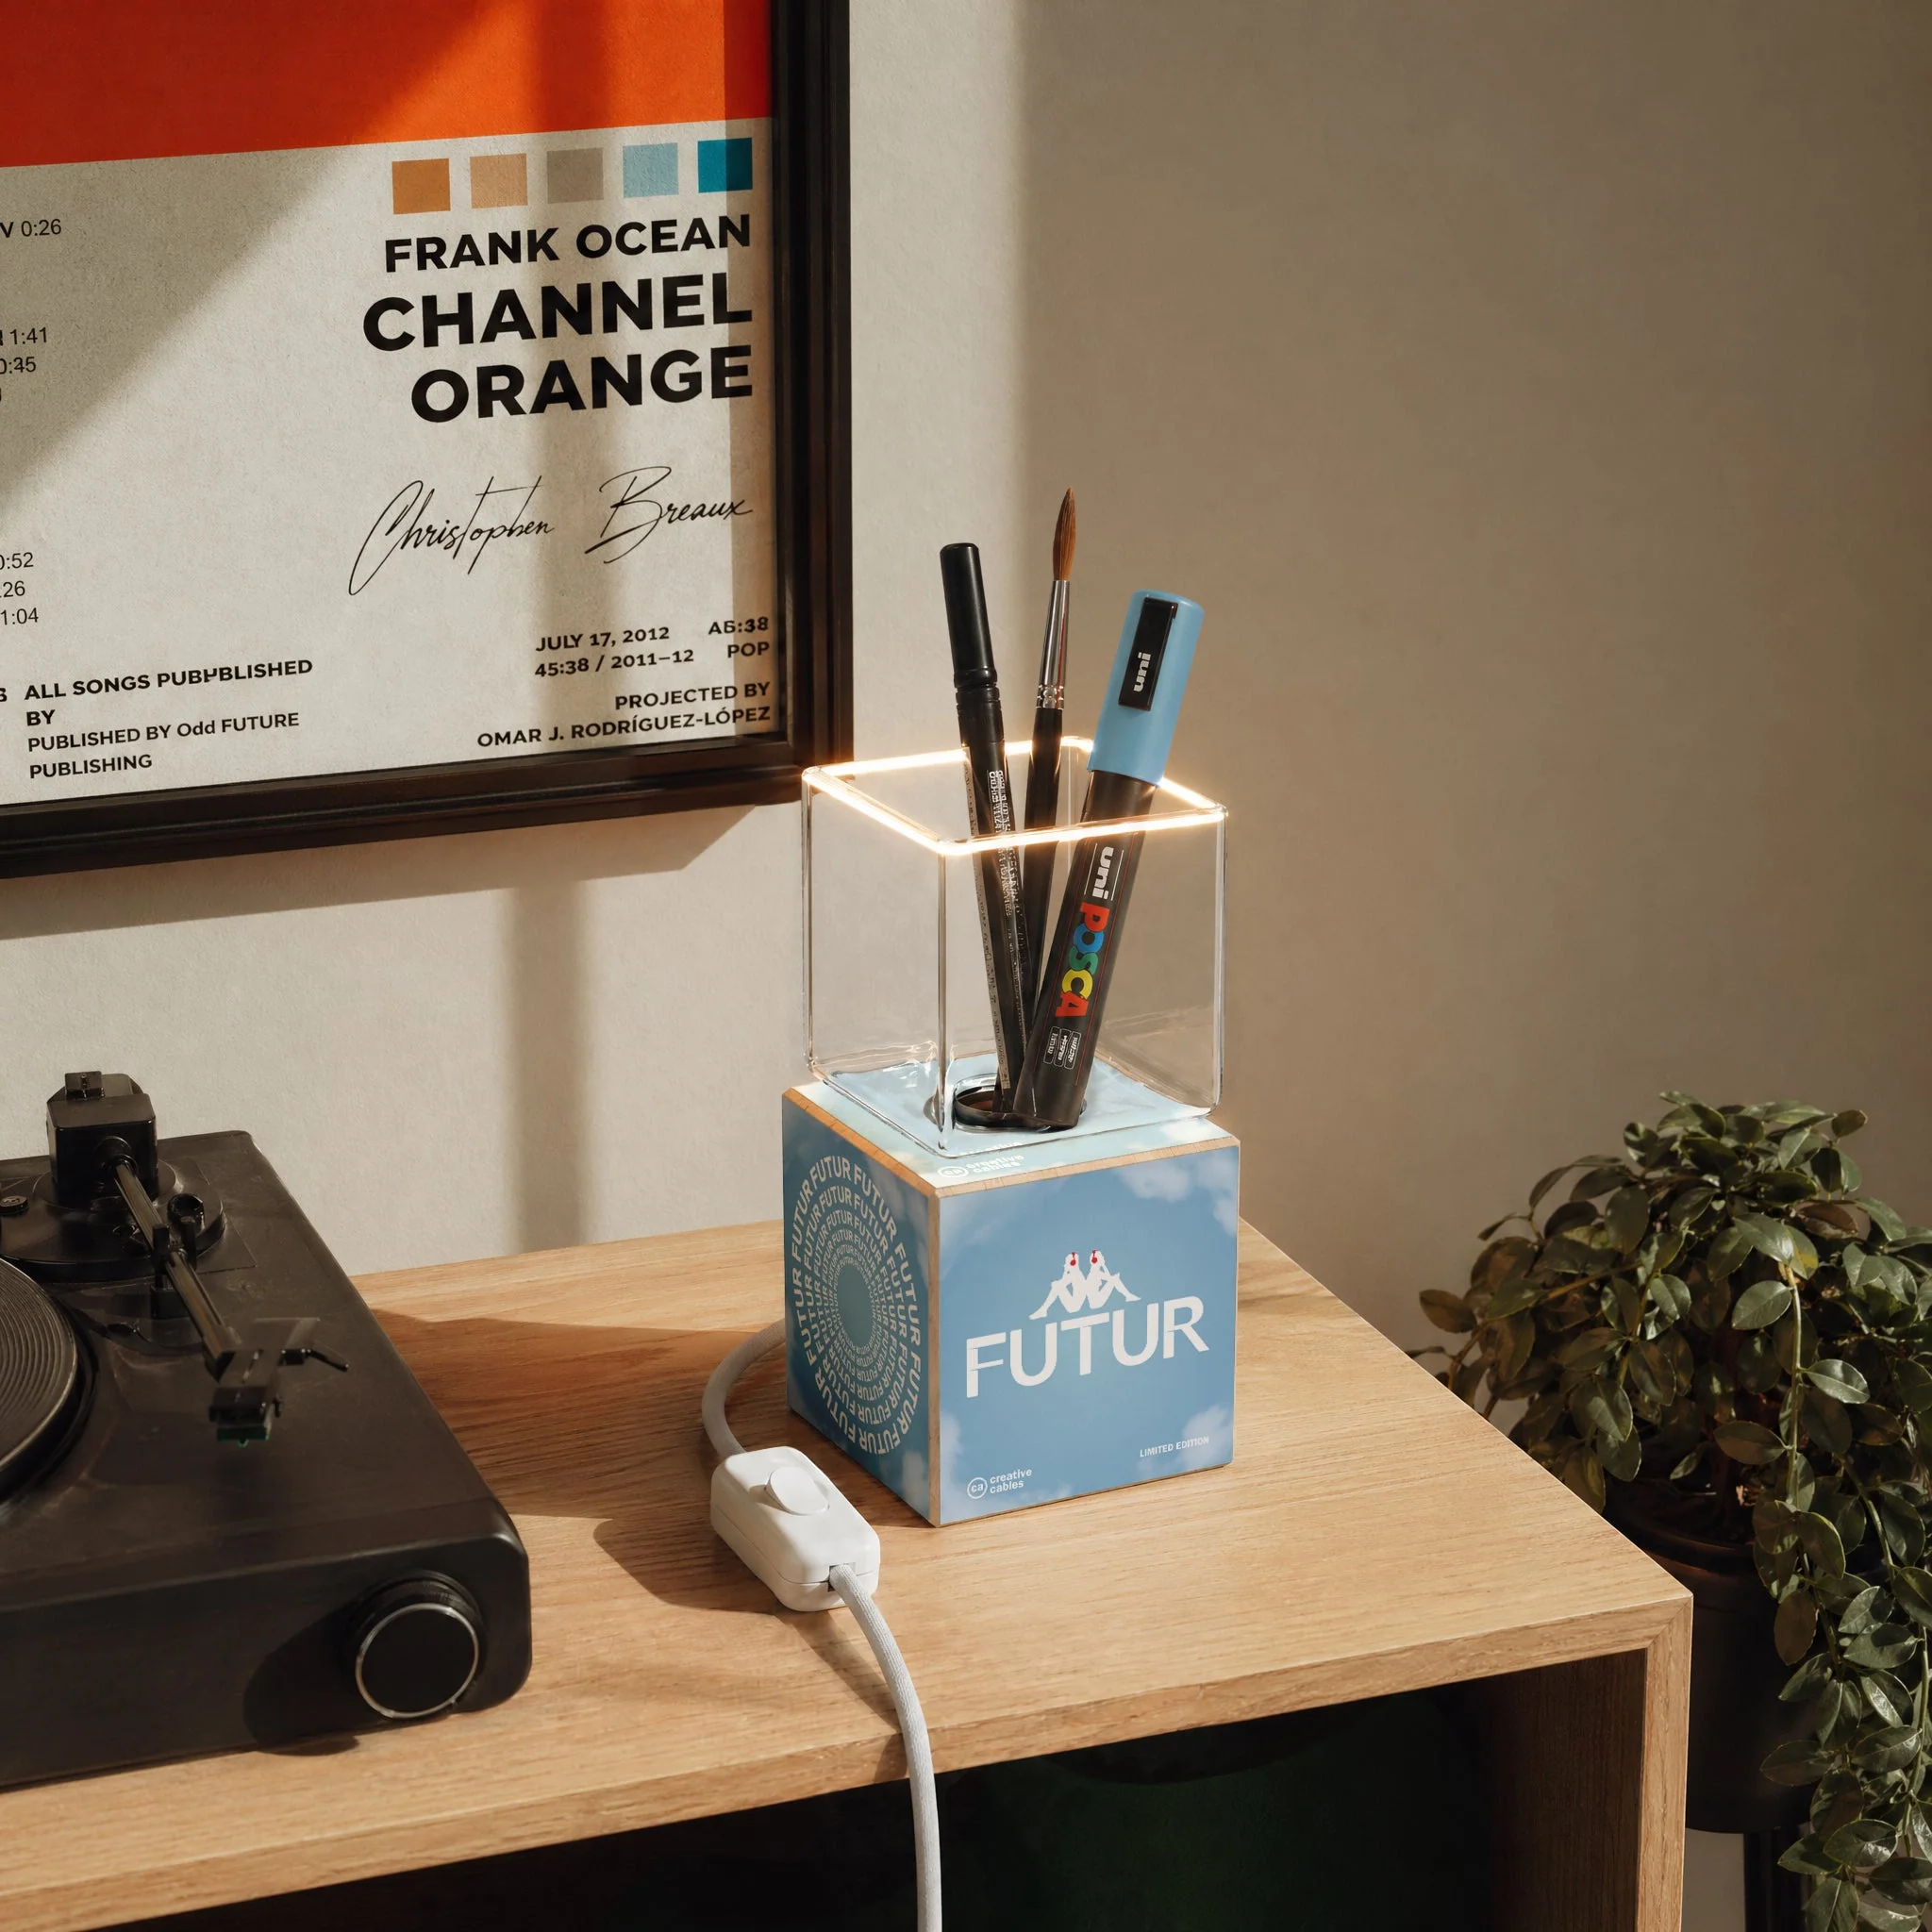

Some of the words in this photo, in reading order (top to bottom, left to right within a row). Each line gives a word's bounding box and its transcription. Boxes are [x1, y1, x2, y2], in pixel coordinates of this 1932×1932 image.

[21, 218, 61, 236] 0:26
[385, 227, 560, 273] FRANK
[575, 214, 751, 258] OCEAN
[9, 326, 47, 344] 1:41
[363, 272, 753, 351] CHANNEL
[411, 345, 753, 424] ORANGE
[585, 466, 753, 565] Breaux
[536, 633, 583, 652] JULY
[590, 632, 617, 648] 17,
[623, 626, 671, 643] 2012
[727, 641, 770, 658] POP
[25, 683, 66, 701] ALL
[73, 675, 151, 695] SONGS
[535, 658, 590, 677] 45:38
[594, 656, 606, 673] /
[1133, 652, 1151, 691] uni
[25, 709, 56, 726] BY
[615, 686, 738, 710] PROJECTED
[744, 682, 771, 698] BY
[28, 729, 140, 752] PUBLISHED
[146, 724, 172, 741] BY
[176, 721, 215, 738] Odd
[221, 712, 299, 733] FUTURE
[477, 729, 541, 747] OMAR
[548, 727, 564, 741] J.
[571, 706, 771, 740] RODRÍGUEZ-LÓPEZ
[30, 754, 153, 779] PUBLISHING
[1092, 846, 1114, 900] uni
[1055, 902, 1110, 1017] POSCA
[808, 1154, 851, 1191] FUTUR
[818, 1185, 852, 1213] FUTUR
[791, 1175, 813, 1263] FUTUR
[825, 1209, 852, 1232] FUTUR
[854, 1162, 897, 1242] FUTUR
[854, 1191, 889, 1256] FUTUR
[804, 1202, 822, 1272] FUTUR
[814, 1223, 828, 1278] FUTUR
[854, 1214, 881, 1266] FUTUR
[791, 1266, 816, 1367] FUTUR
[804, 1274, 824, 1355] FUTUR
[814, 1280, 830, 1345] FUTUR
[879, 1263, 896, 1331] FUTUR
[886, 1253, 907, 1338] FUTUR
[893, 1240, 920, 1346] FUTUR
[828, 1343, 855, 1394] FUTUR
[880, 1333, 896, 1389] FUTUR
[966, 1296, 1209, 1398] FUTUR
[822, 1353, 855, 1416] FUTUR
[857, 1379, 883, 1400] FUTUR
[887, 1340, 907, 1409] FUTUR
[895, 1349, 921, 1437] FUTUR
[813, 1365, 855, 1444] FUTUR
[857, 1397, 891, 1424] FUTUR
[858, 1421, 900, 1454] FUTUR
[1140, 1442, 1174, 1457] LIMITED
[1176, 1437, 1209, 1451] EDITION
[990, 1468, 1033, 1484] creative
[990, 1479, 1024, 1495] cables
